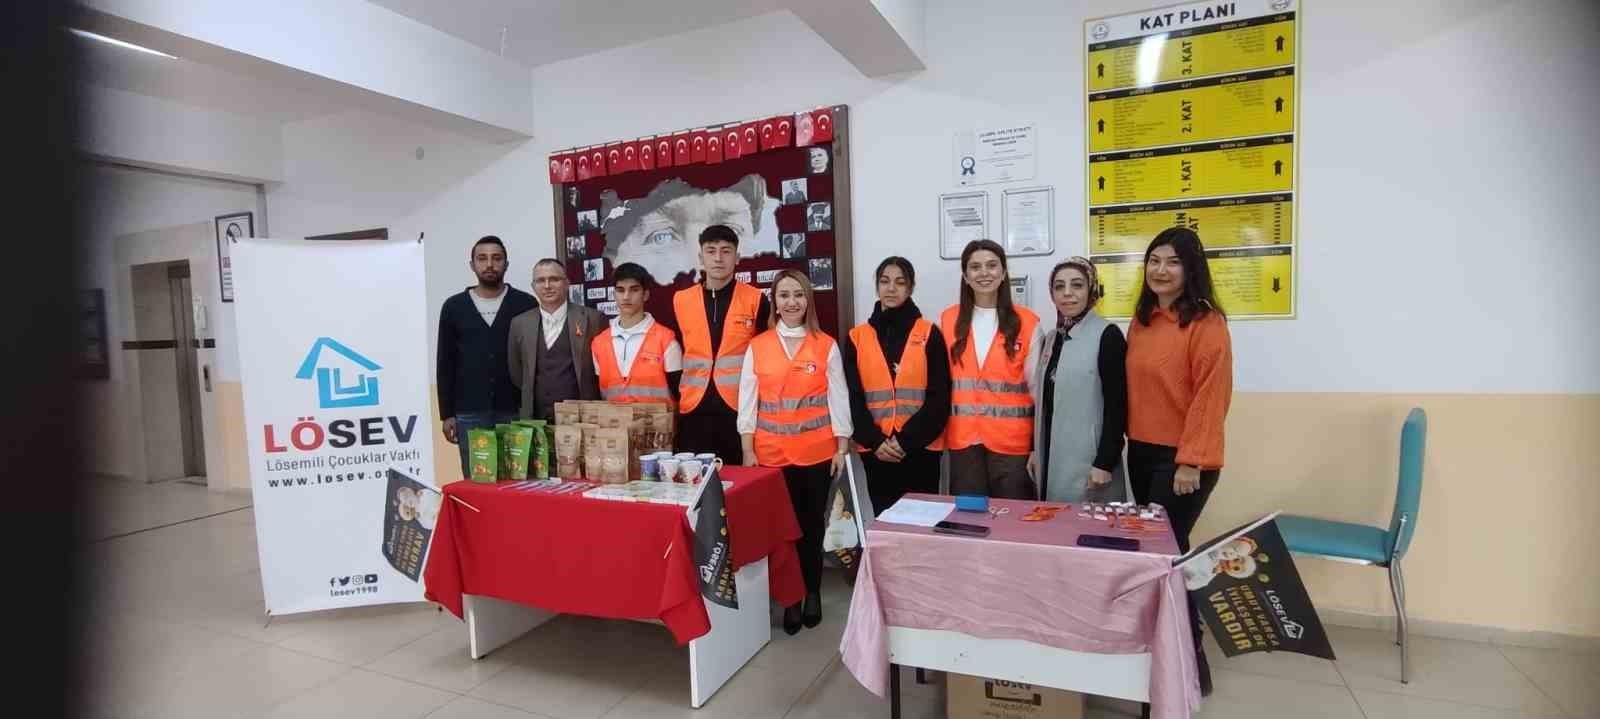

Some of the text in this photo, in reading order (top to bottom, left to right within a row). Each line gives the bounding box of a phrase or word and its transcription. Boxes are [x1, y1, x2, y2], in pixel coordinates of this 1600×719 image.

[1140, 3, 1235, 30] KAT PLANI
[1182, 41, 1192, 62] KAT
[1182, 100, 1192, 120] KAT
[1181, 160, 1192, 181] KAT
[264, 415, 418, 453] LÖSEV
[267, 449, 420, 472] Lösemili Çocuklar Vakfı
[1208, 591, 1253, 650] VARDIR
